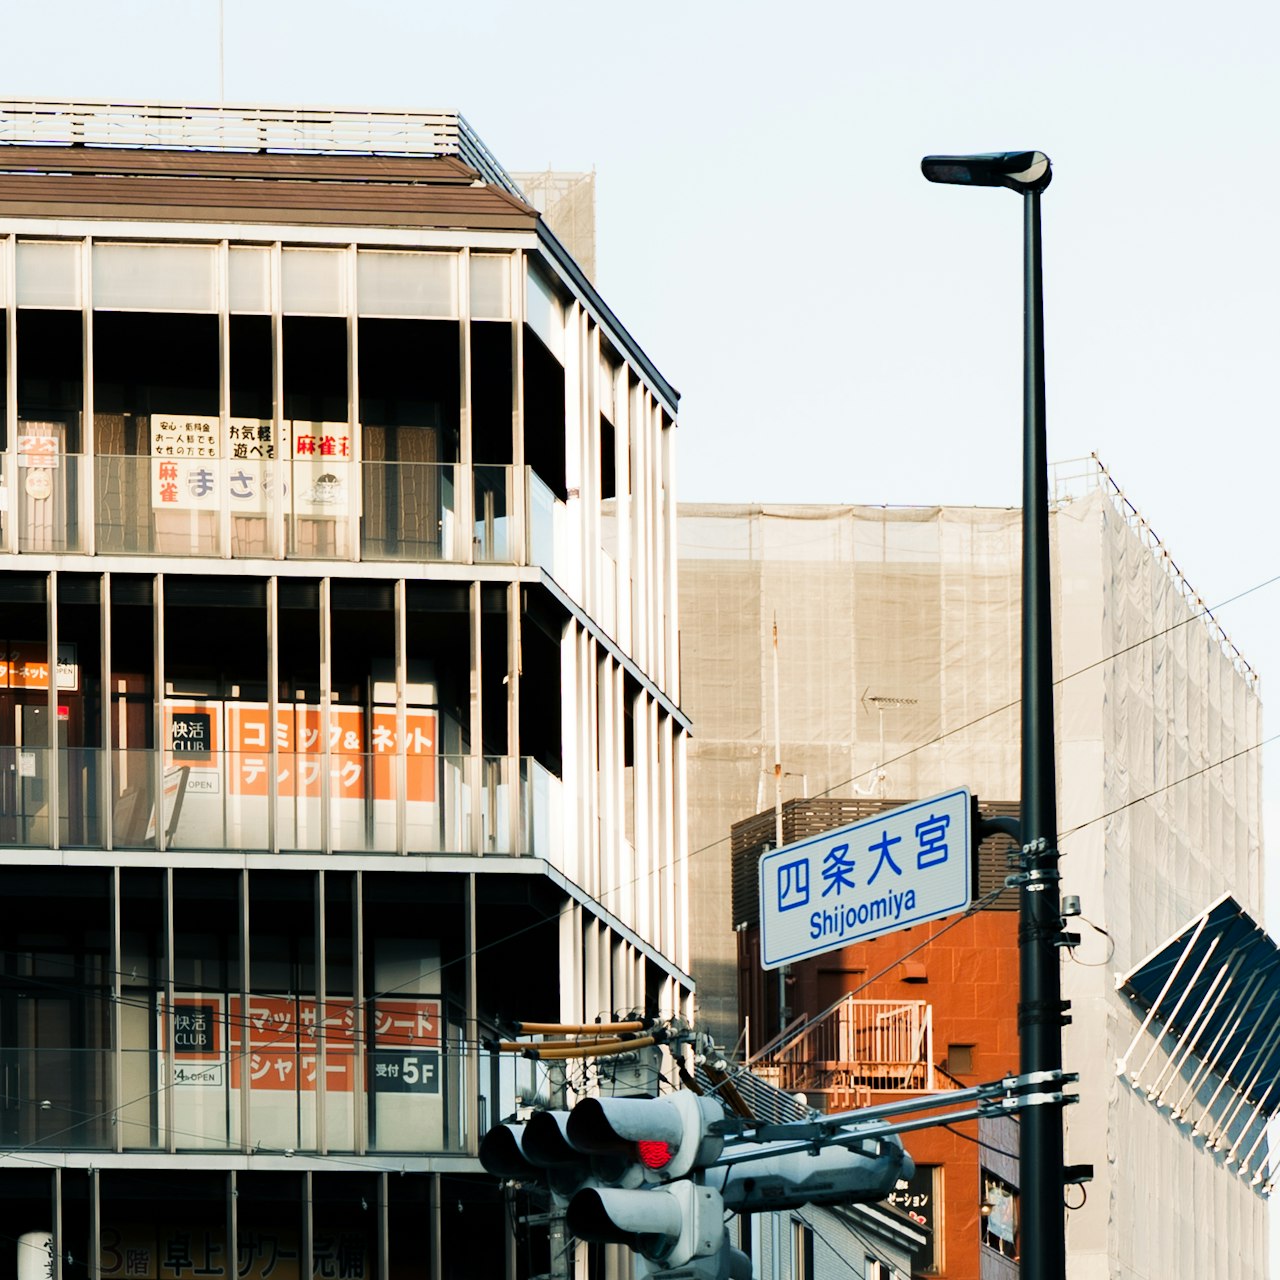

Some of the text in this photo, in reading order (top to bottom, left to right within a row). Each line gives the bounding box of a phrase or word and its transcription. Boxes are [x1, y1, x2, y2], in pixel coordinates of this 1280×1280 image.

[158, 461, 180, 502] 麻雀
[171, 720, 204, 739] 快活
[777, 814, 951, 912] 四条大宮
[809, 889, 917, 940] Shijoomiya
[173, 1012, 206, 1031] 快活
[175, 1031, 207, 1047] CLUB
[251, 1054, 346, 1082] シャワー
[375, 1057, 434, 1085] 受付 5F
